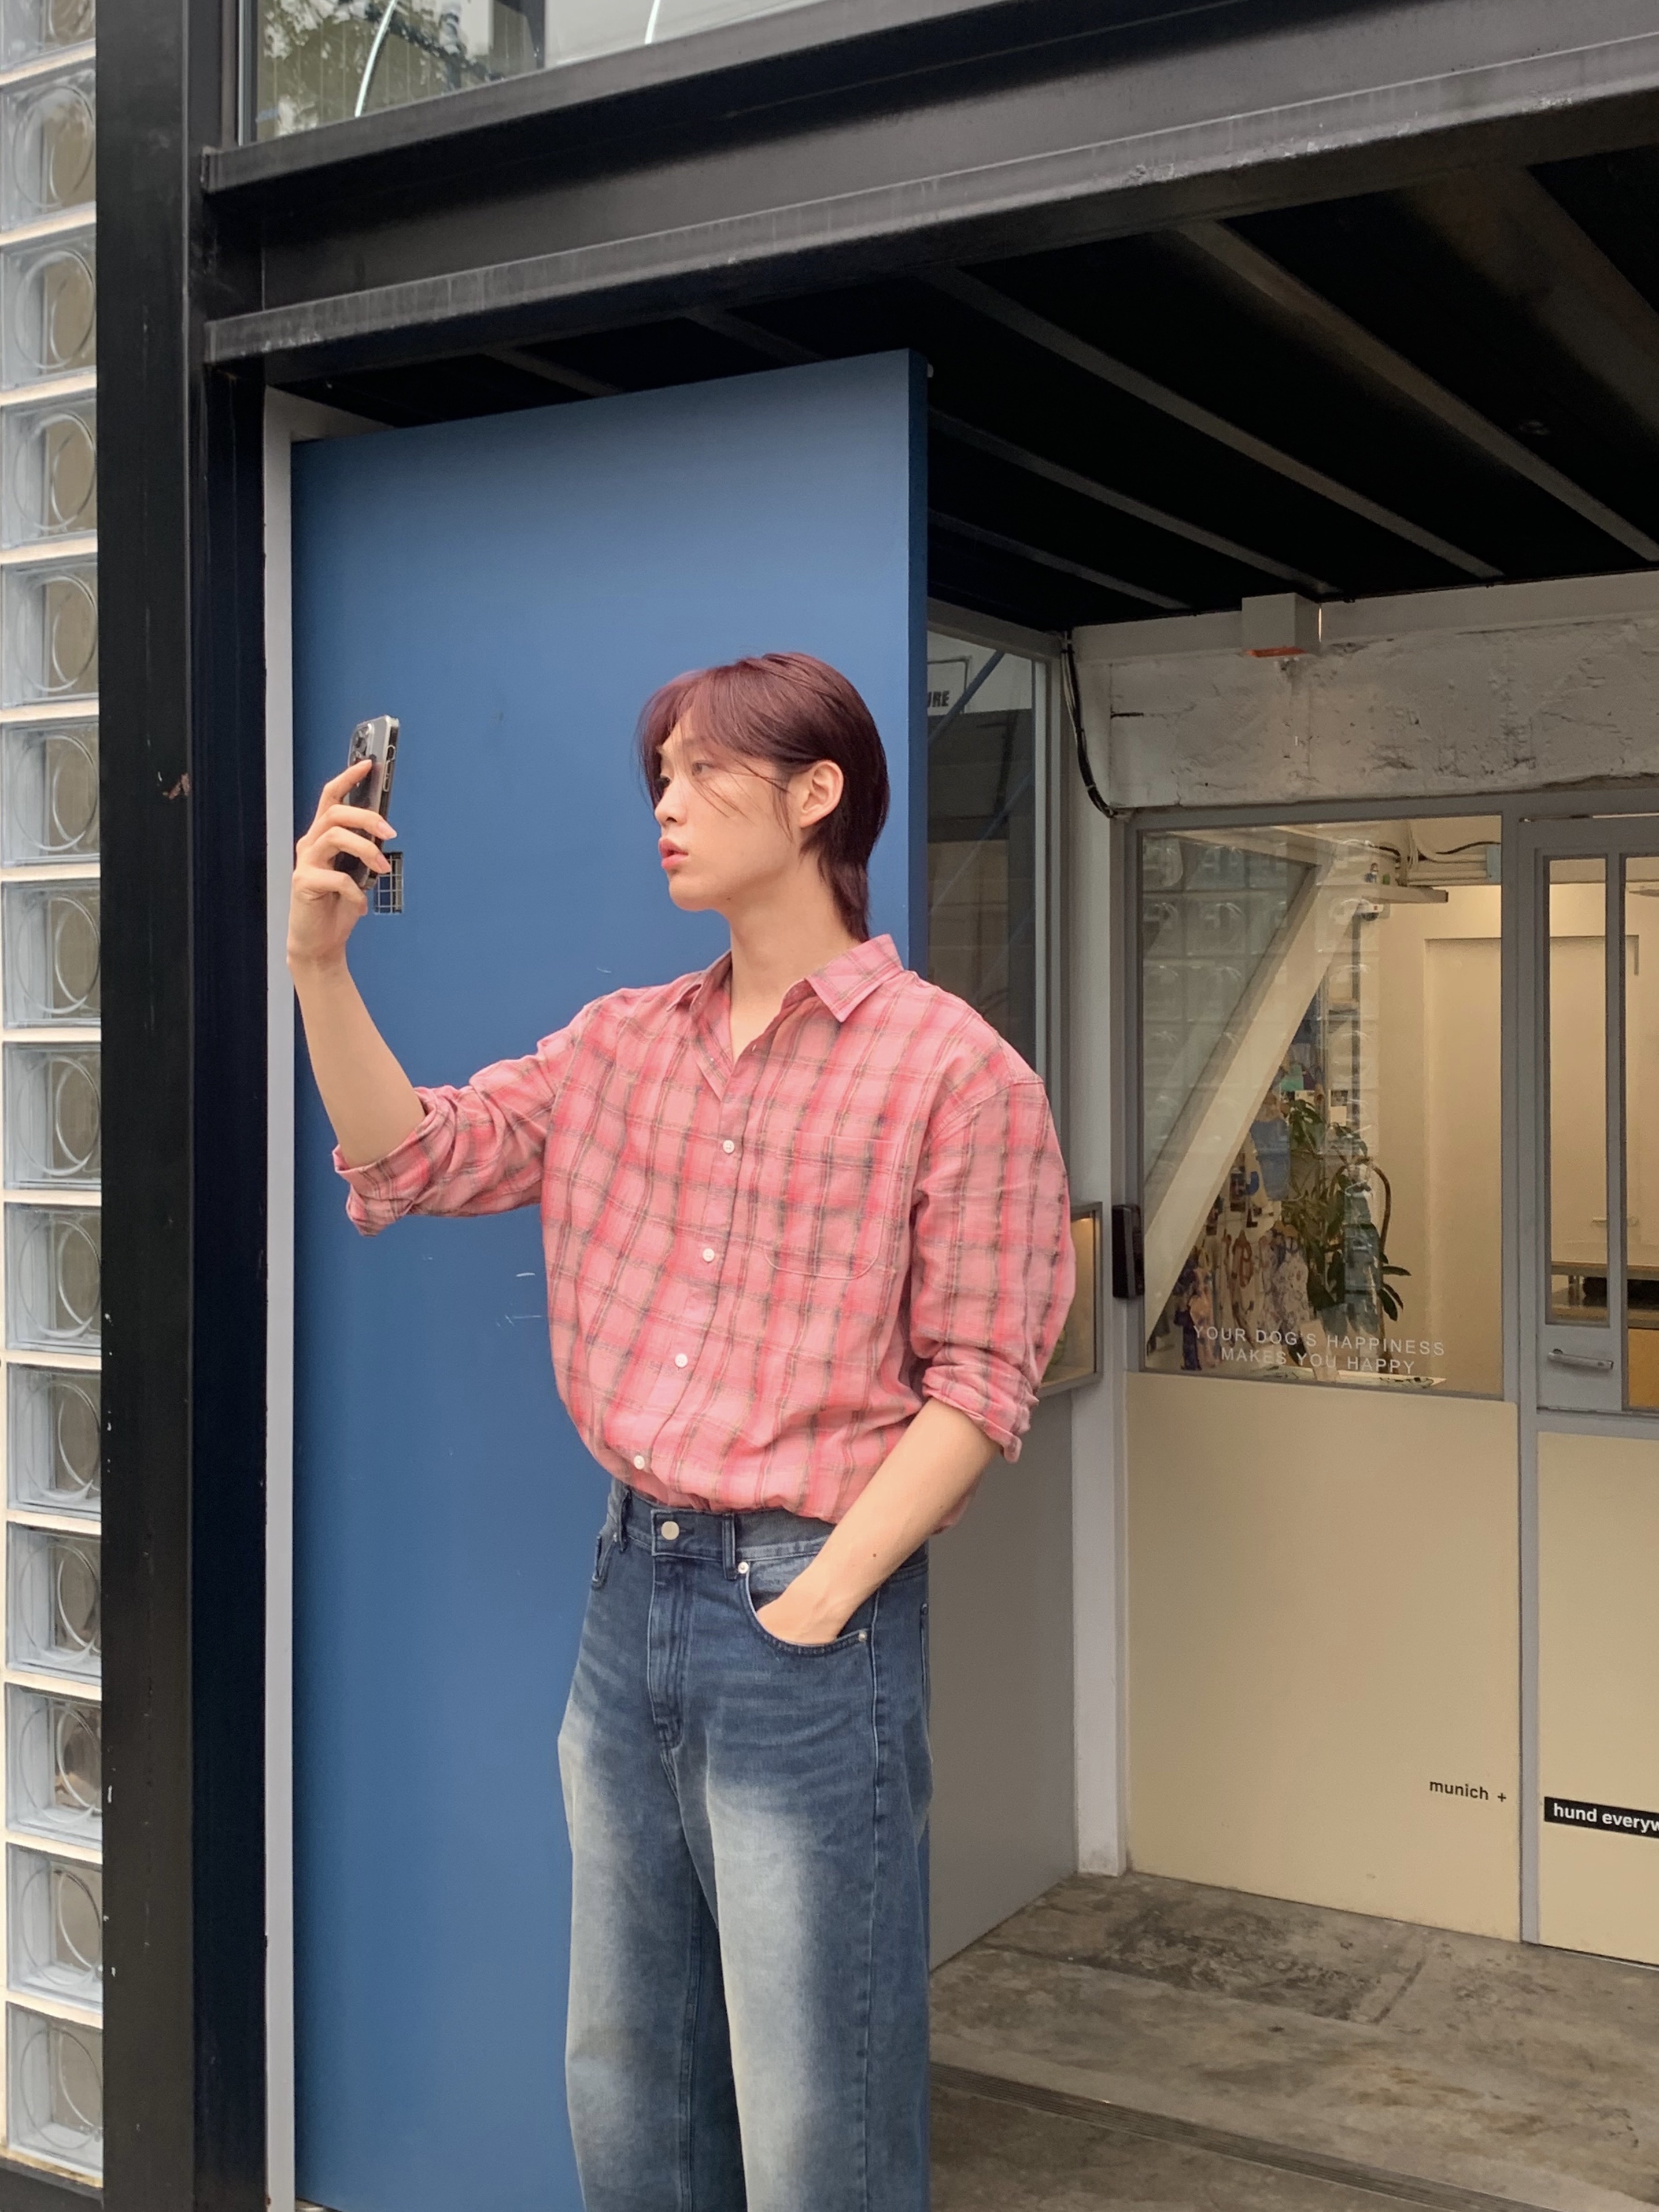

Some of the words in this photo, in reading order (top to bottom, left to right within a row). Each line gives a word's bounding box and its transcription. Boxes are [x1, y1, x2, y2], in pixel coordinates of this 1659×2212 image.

[1193, 1325, 1246, 1342] YOUR
[1255, 1330, 1317, 1347] DOG'S
[1327, 1334, 1445, 1356] HAPPINESS
[1221, 1347, 1287, 1365] MAKES
[1296, 1351, 1337, 1368] YOU
[1347, 1356, 1415, 1375] HAPPY
[1429, 1781, 1489, 1800] munich
[1553, 1803, 1598, 1823] hund
